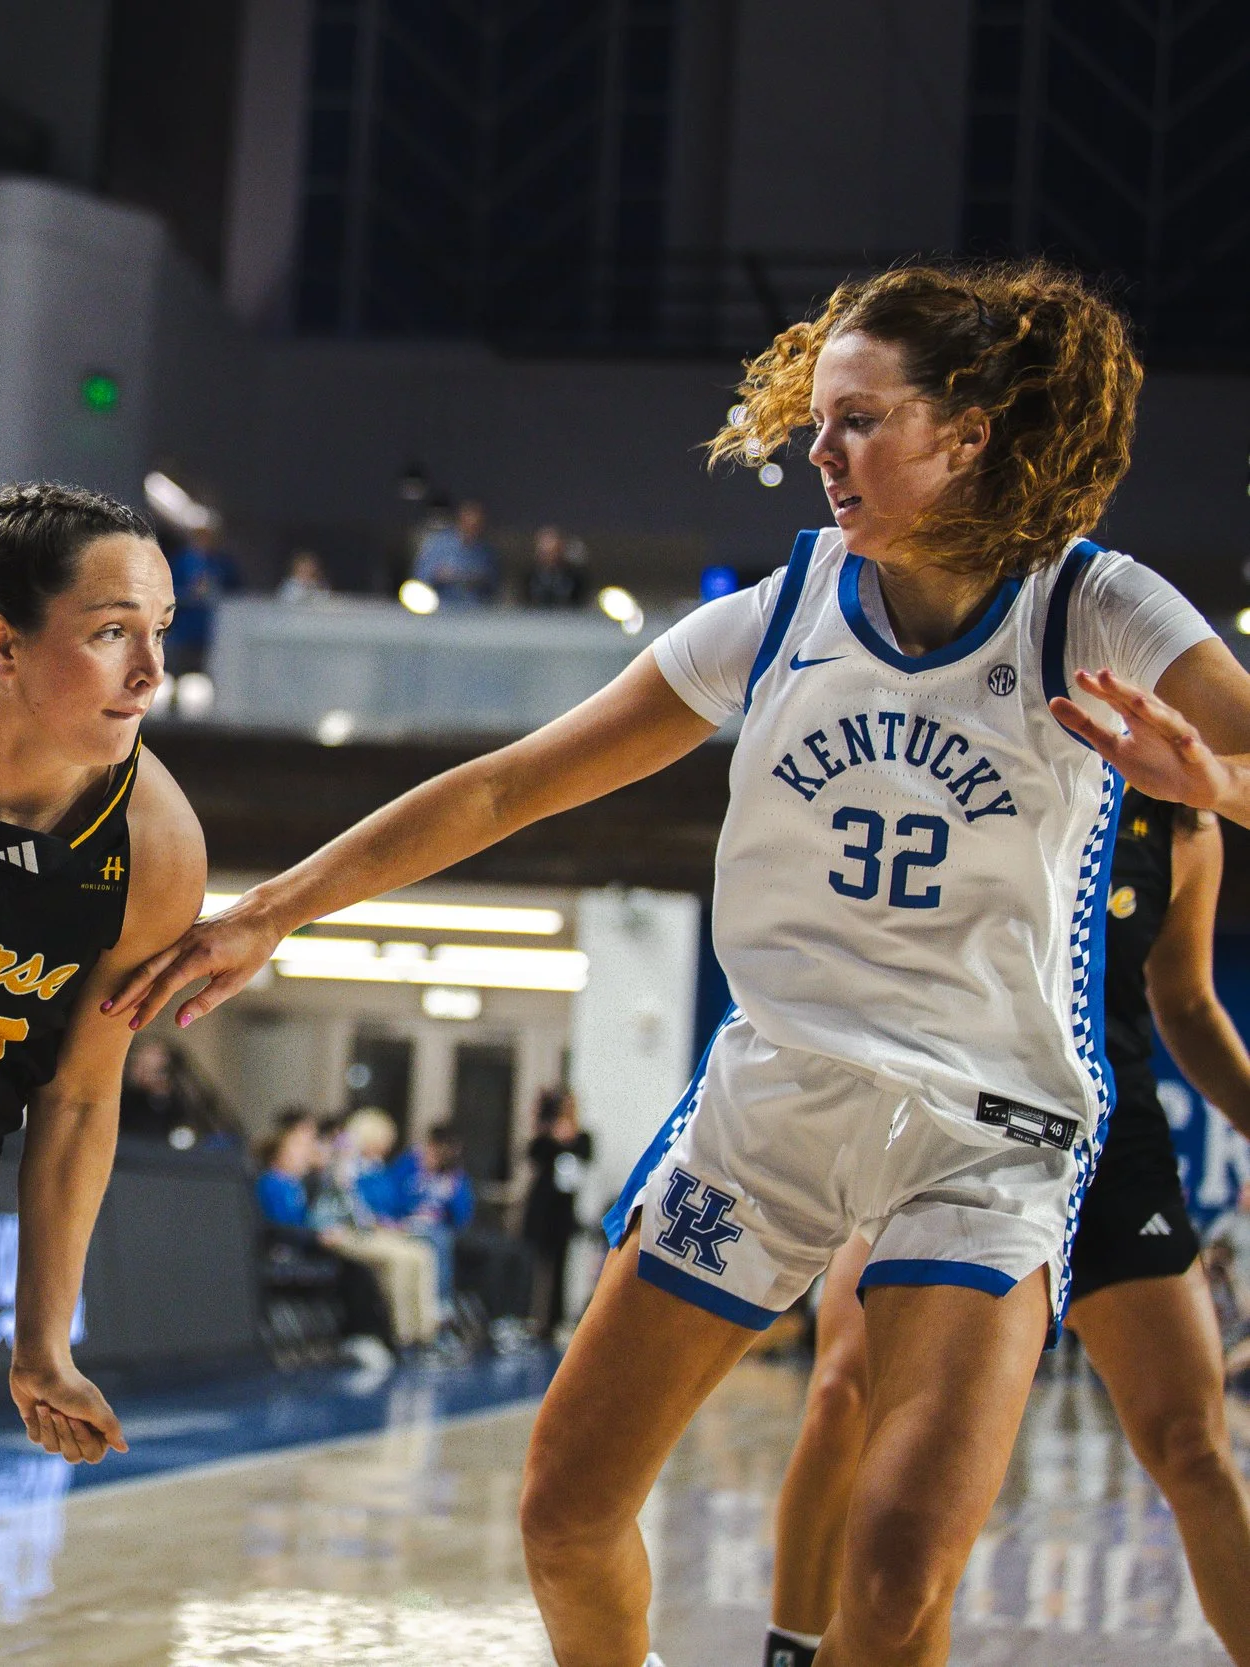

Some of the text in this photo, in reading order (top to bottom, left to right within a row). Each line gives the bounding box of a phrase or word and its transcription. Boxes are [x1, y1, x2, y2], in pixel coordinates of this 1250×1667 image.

[989, 666, 1015, 695] SEC
[771, 711, 1018, 823] KENTUCKY
[828, 806, 950, 909] 32
[656, 1168, 743, 1276] UK
